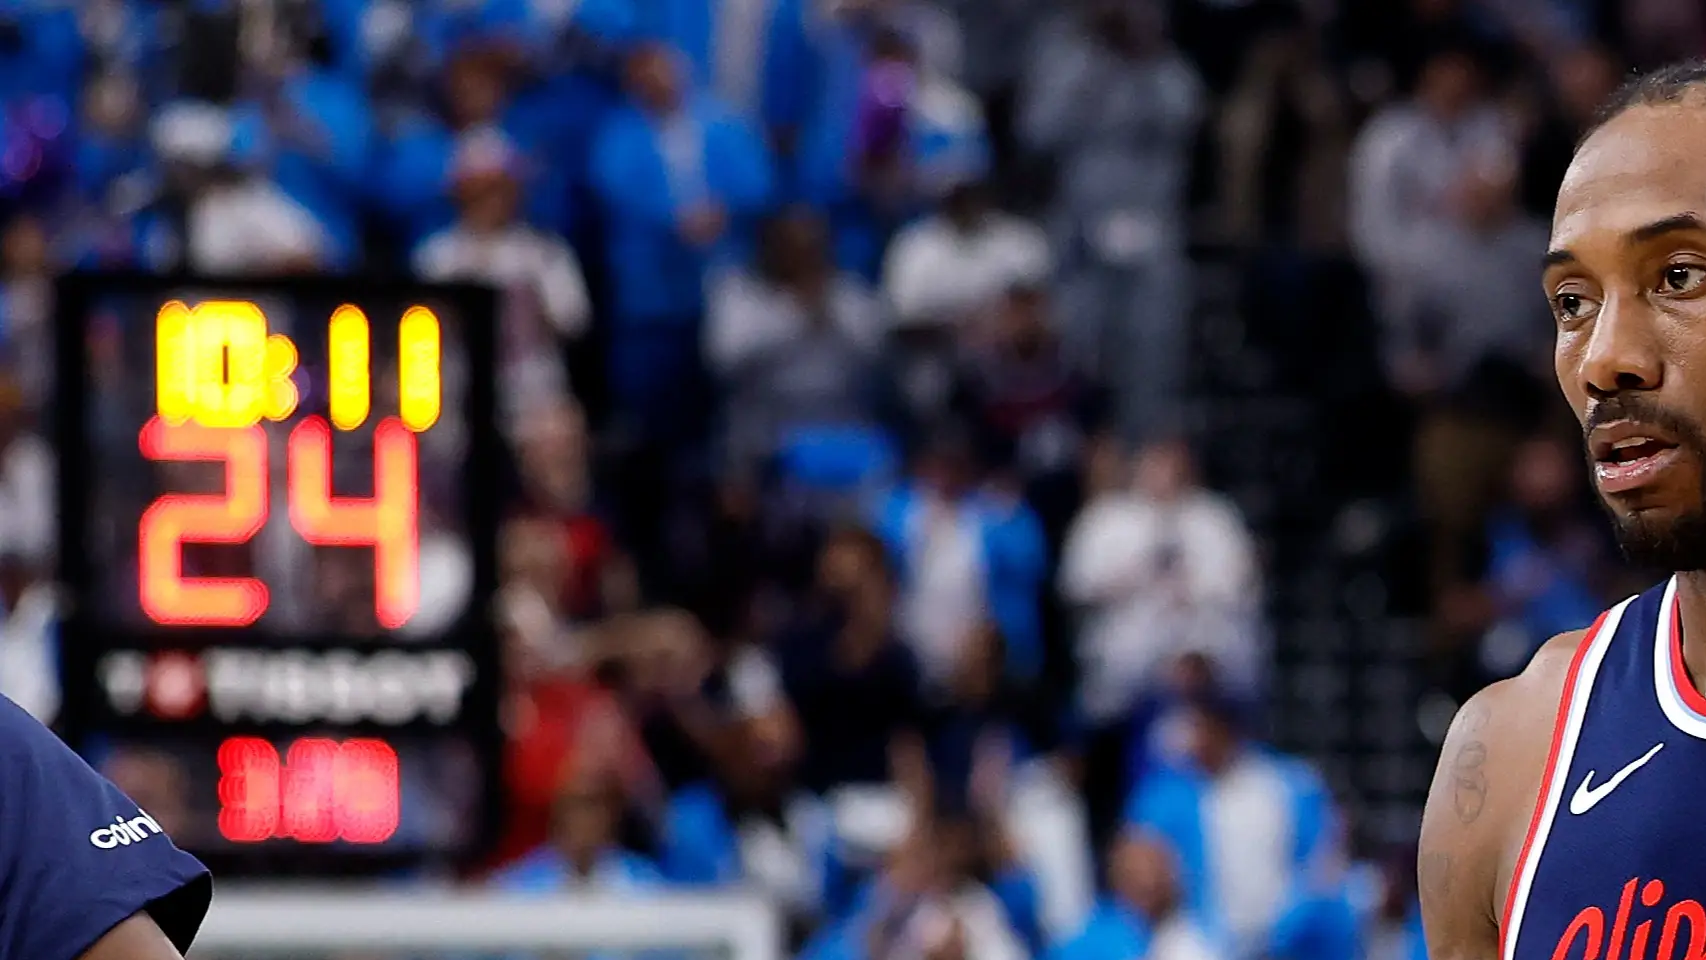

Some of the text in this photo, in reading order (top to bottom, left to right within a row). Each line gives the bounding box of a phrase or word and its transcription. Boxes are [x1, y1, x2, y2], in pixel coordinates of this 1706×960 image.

[156, 300, 441, 432] 10:11
[138, 414, 420, 629] 24
[90, 807, 164, 849] coin
